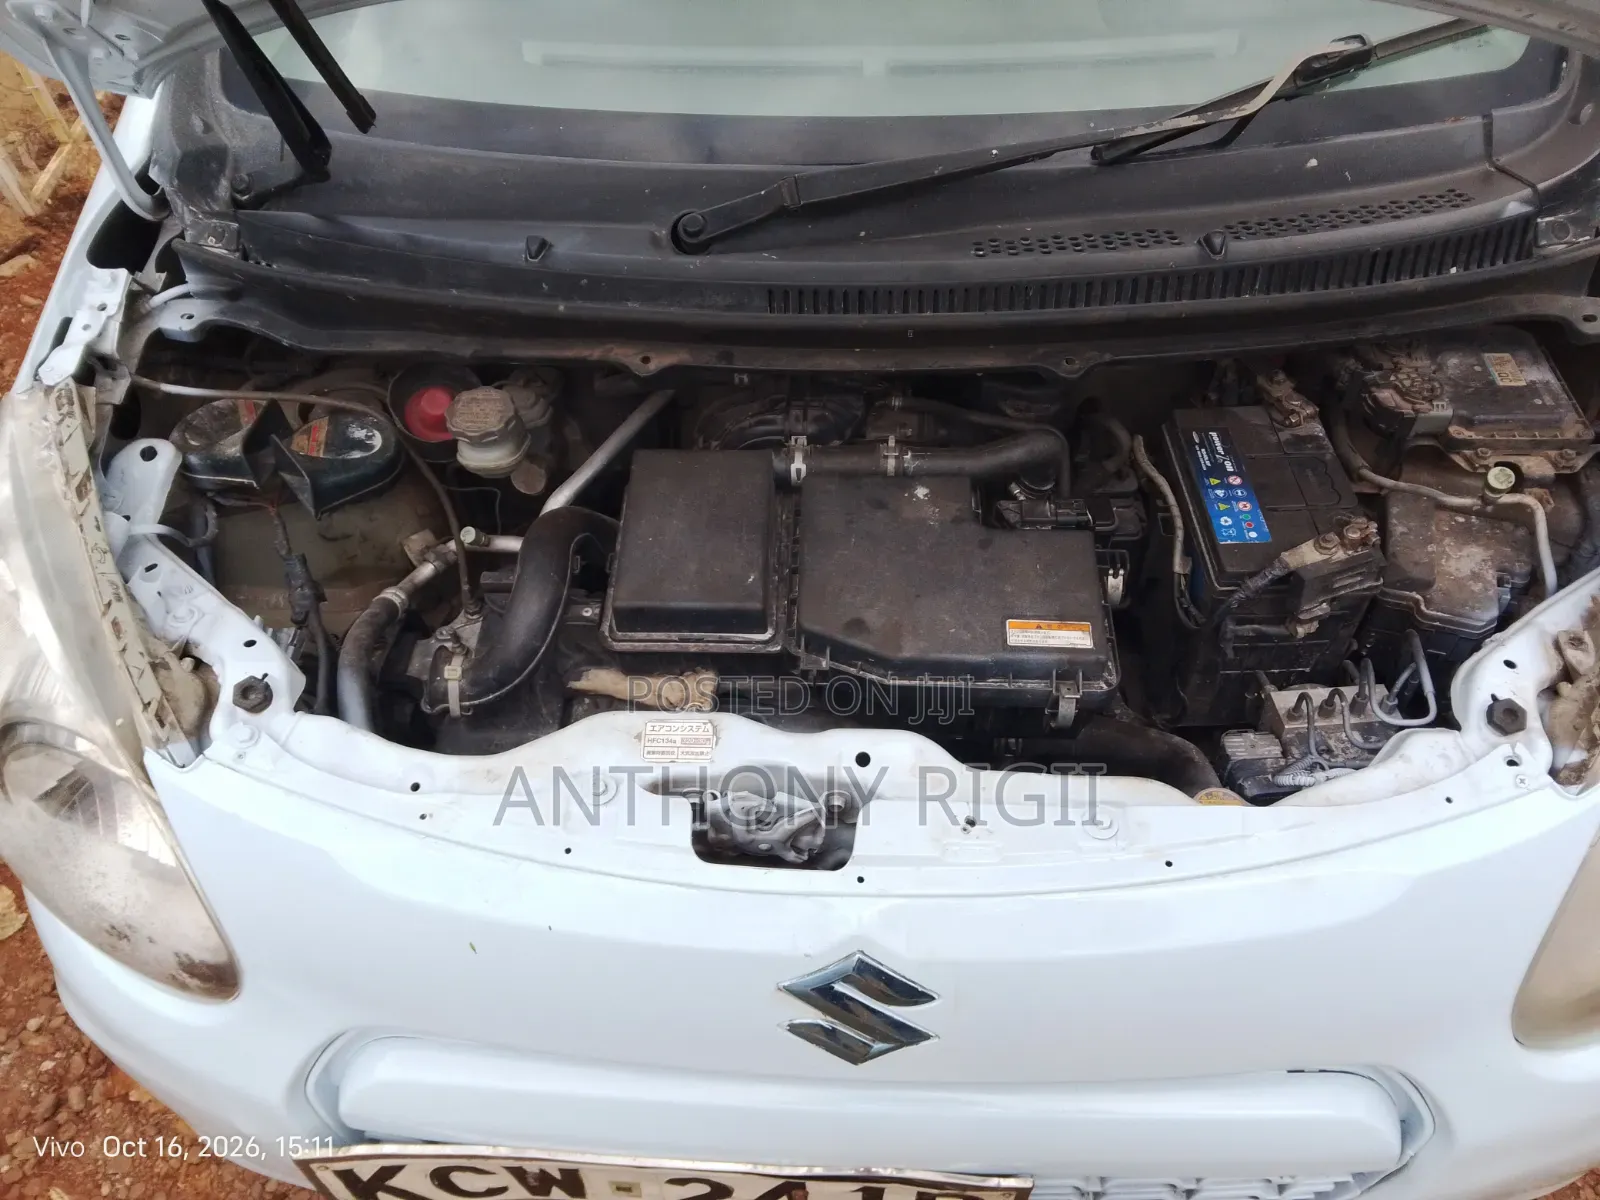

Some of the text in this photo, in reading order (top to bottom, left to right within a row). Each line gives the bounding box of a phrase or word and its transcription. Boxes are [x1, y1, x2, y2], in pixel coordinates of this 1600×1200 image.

[649, 724, 710, 733] エアコンシステム
[647, 737, 677, 745] HFC134a
[333, 1164, 587, 1200] KCW
